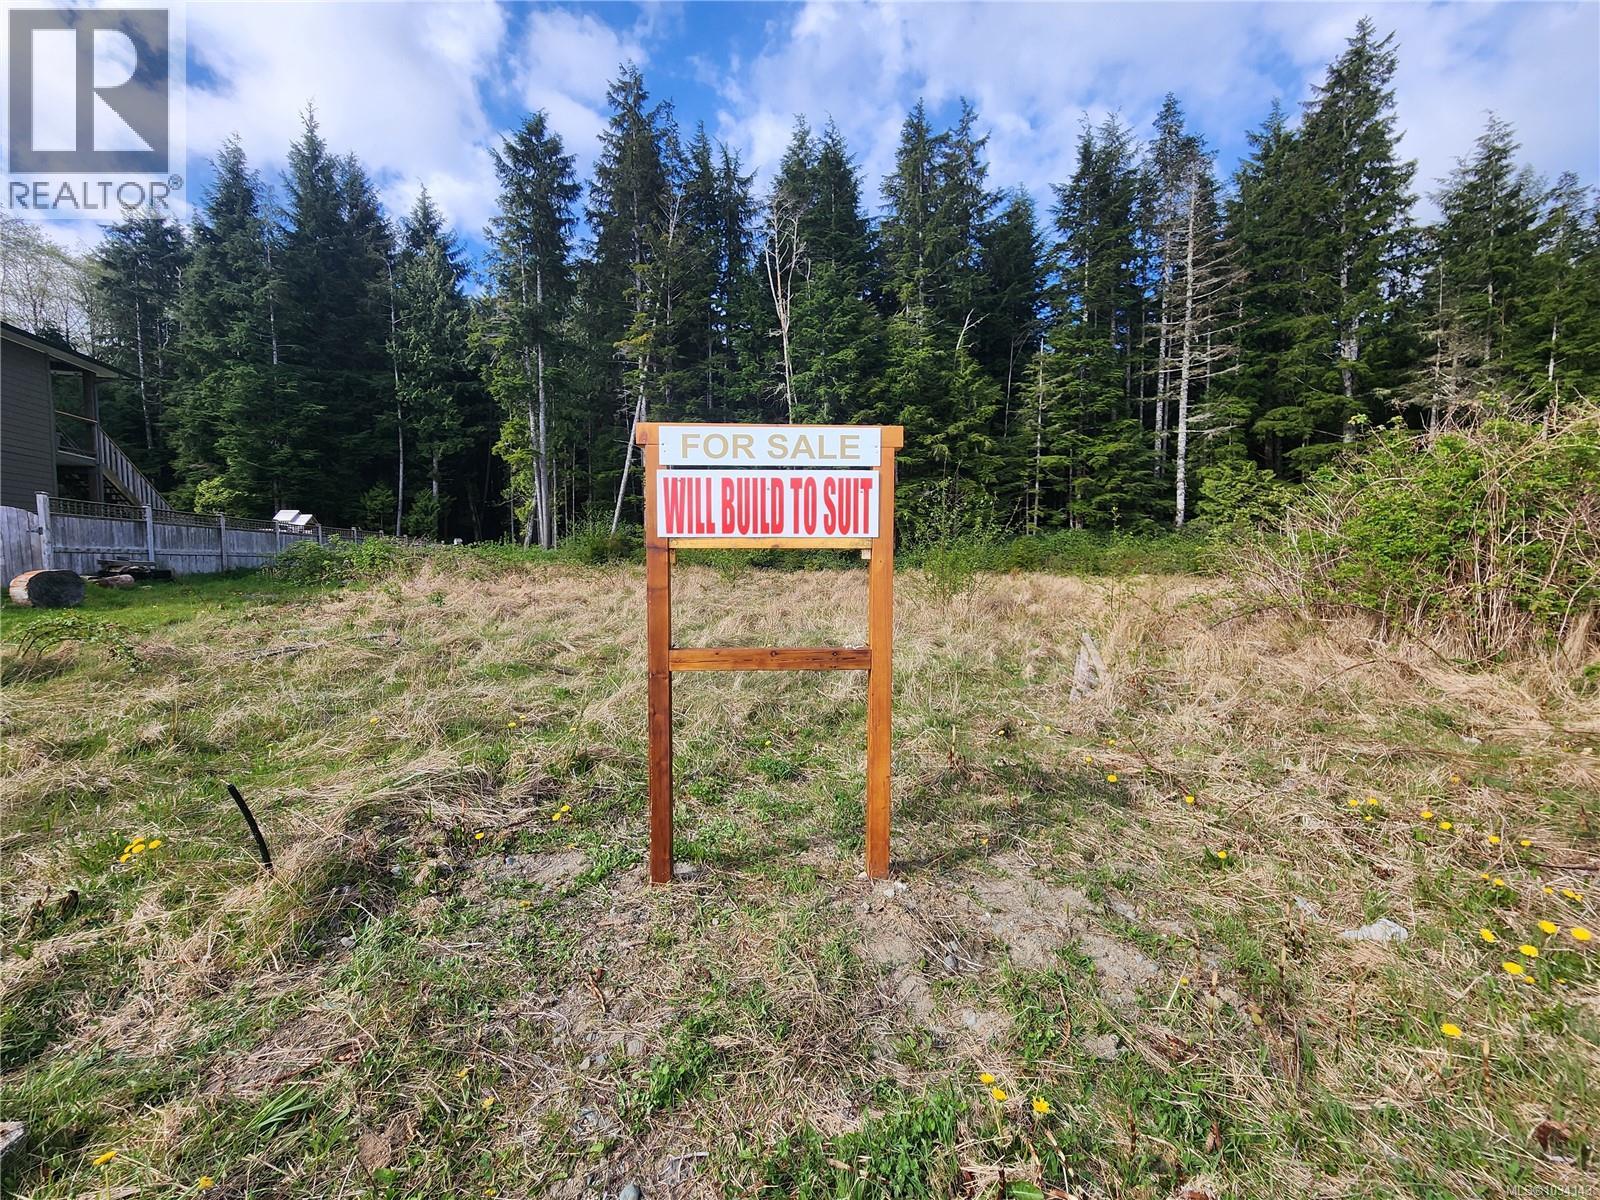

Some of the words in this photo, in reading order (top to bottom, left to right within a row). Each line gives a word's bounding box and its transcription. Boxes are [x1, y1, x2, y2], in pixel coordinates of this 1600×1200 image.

[681, 433, 756, 460] FOR
[767, 434, 861, 460] SALE
[663, 477, 715, 535] WILL
[721, 477, 784, 536] BUILD
[790, 476, 817, 536] TO
[823, 476, 873, 536] SUIT
